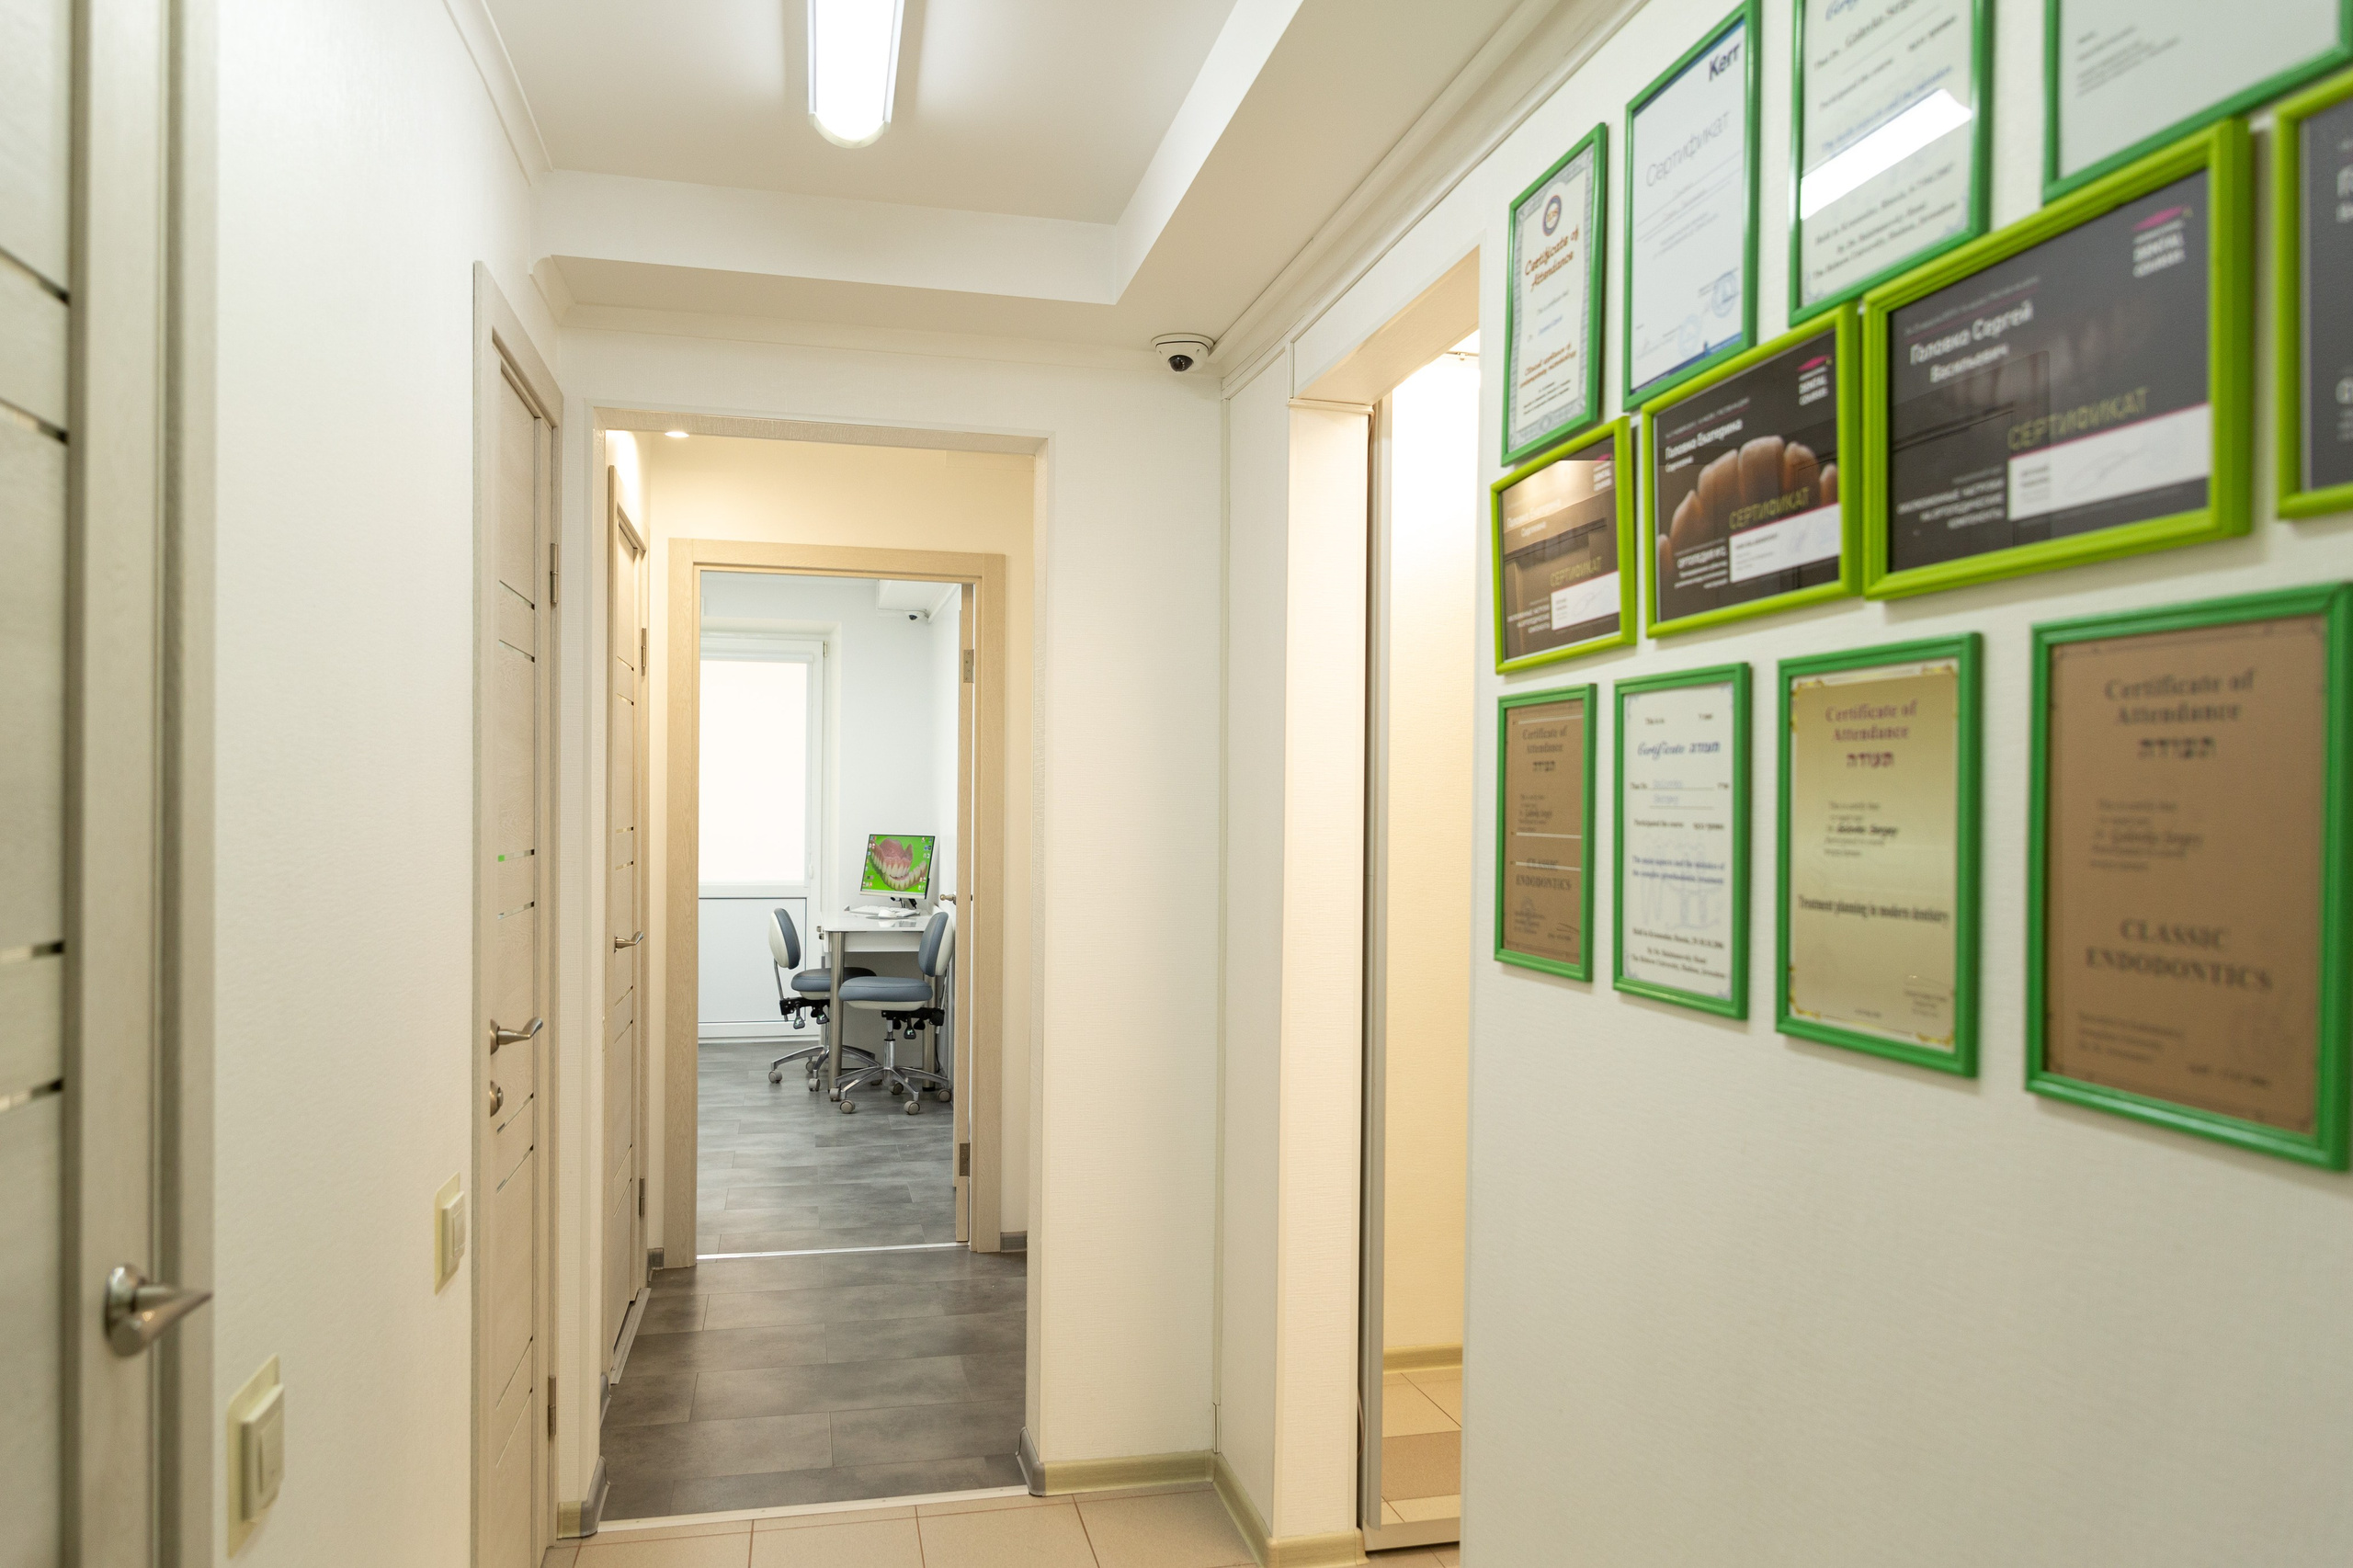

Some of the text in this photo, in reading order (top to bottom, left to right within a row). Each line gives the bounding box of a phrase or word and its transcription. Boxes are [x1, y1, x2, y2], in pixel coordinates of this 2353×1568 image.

[1709, 43, 1741, 82] Kerr
[1646, 110, 1730, 187] Сертификат
[1525, 224, 1579, 276] Certificate of
[1530, 251, 1574, 292] Attendance
[1972, 299, 2034, 341] Сергей
[1697, 418, 1744, 447] Екатерина
[2007, 385, 2149, 450] СЕРТИФИКАТ
[1729, 486, 1810, 529] СЕРТИФИКАТ
[1550, 555, 1602, 587] СЕРТИФИКАТ
[2105, 665, 2256, 700] Certificate of
[1824, 699, 1918, 722] Certificate of
[2118, 701, 2241, 725] Attendance
[1522, 727, 1557, 740] Certificate
[1833, 724, 1908, 742] Attendance
[1637, 741, 1685, 760] Certificate
[1798, 893, 1833, 915] Treatment
[1834, 899, 1868, 918] planning
[2119, 917, 2226, 951] CLASSIC
[2085, 945, 2274, 992] ENDODONTICS
